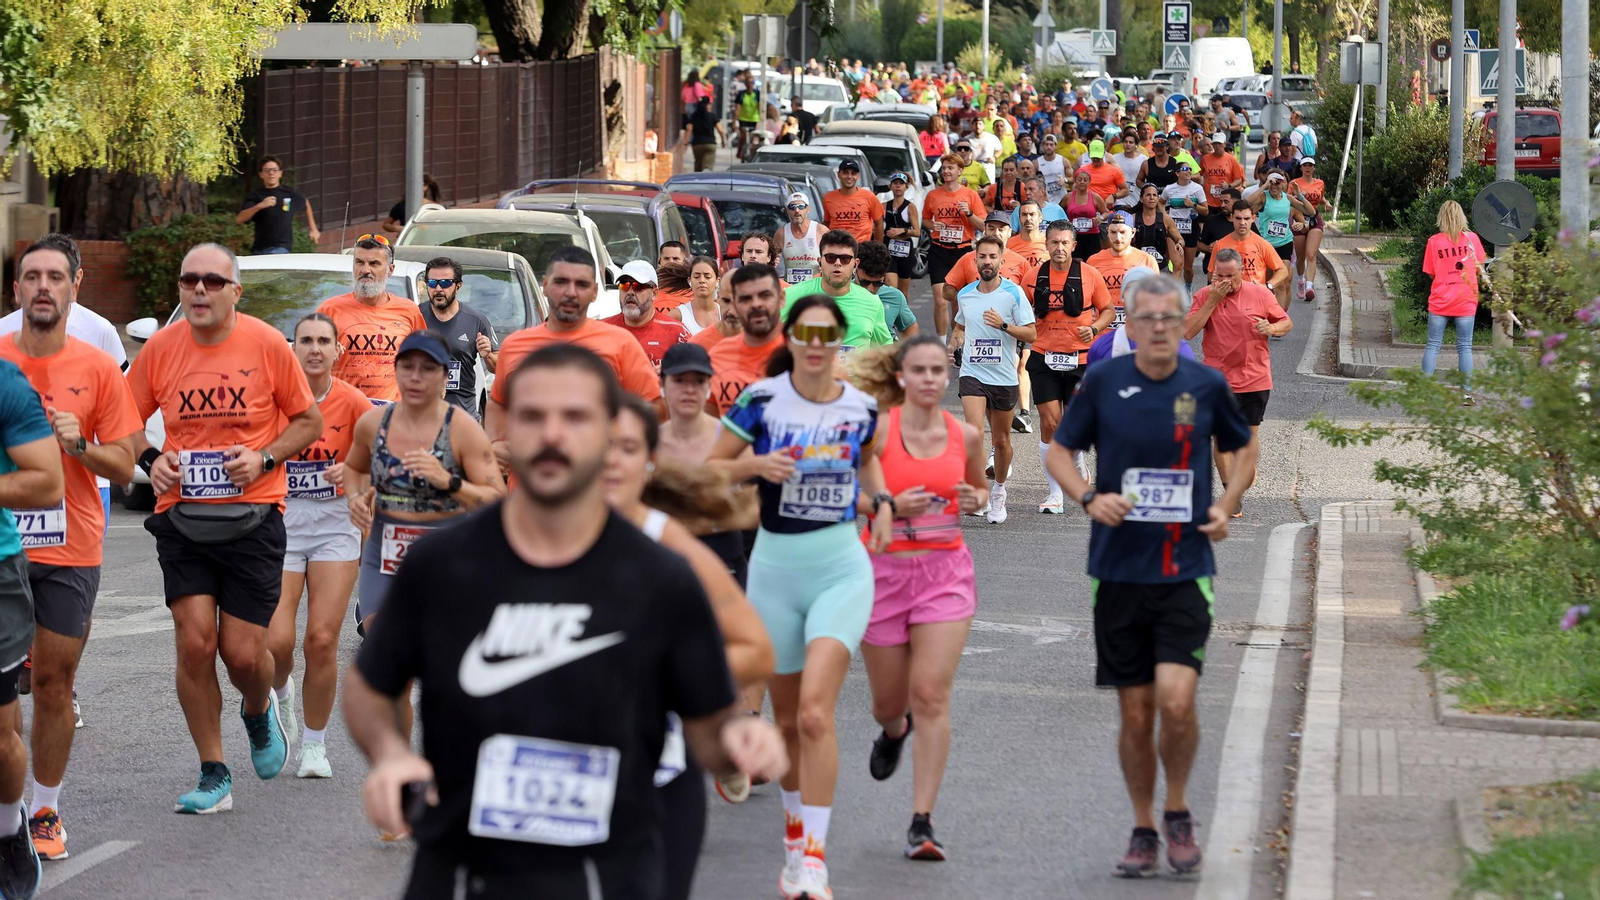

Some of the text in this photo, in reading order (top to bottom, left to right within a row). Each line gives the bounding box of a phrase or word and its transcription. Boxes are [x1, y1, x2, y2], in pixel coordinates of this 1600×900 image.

[835, 211, 861, 220] XXIX
[1438, 246, 1468, 259] STAFF
[346, 334, 398, 351] XXIX
[976, 347, 993, 356] 760
[1052, 355, 1070, 363] 882
[178, 386, 247, 413] XXIX
[202, 411, 237, 419] MARATÓN
[288, 473, 318, 489] 841
[796, 487, 843, 503] 1085
[1140, 488, 1174, 504] 987
[14, 514, 46, 531] 771
[482, 602, 593, 657] NIKE
[506, 775, 586, 808] 1024
